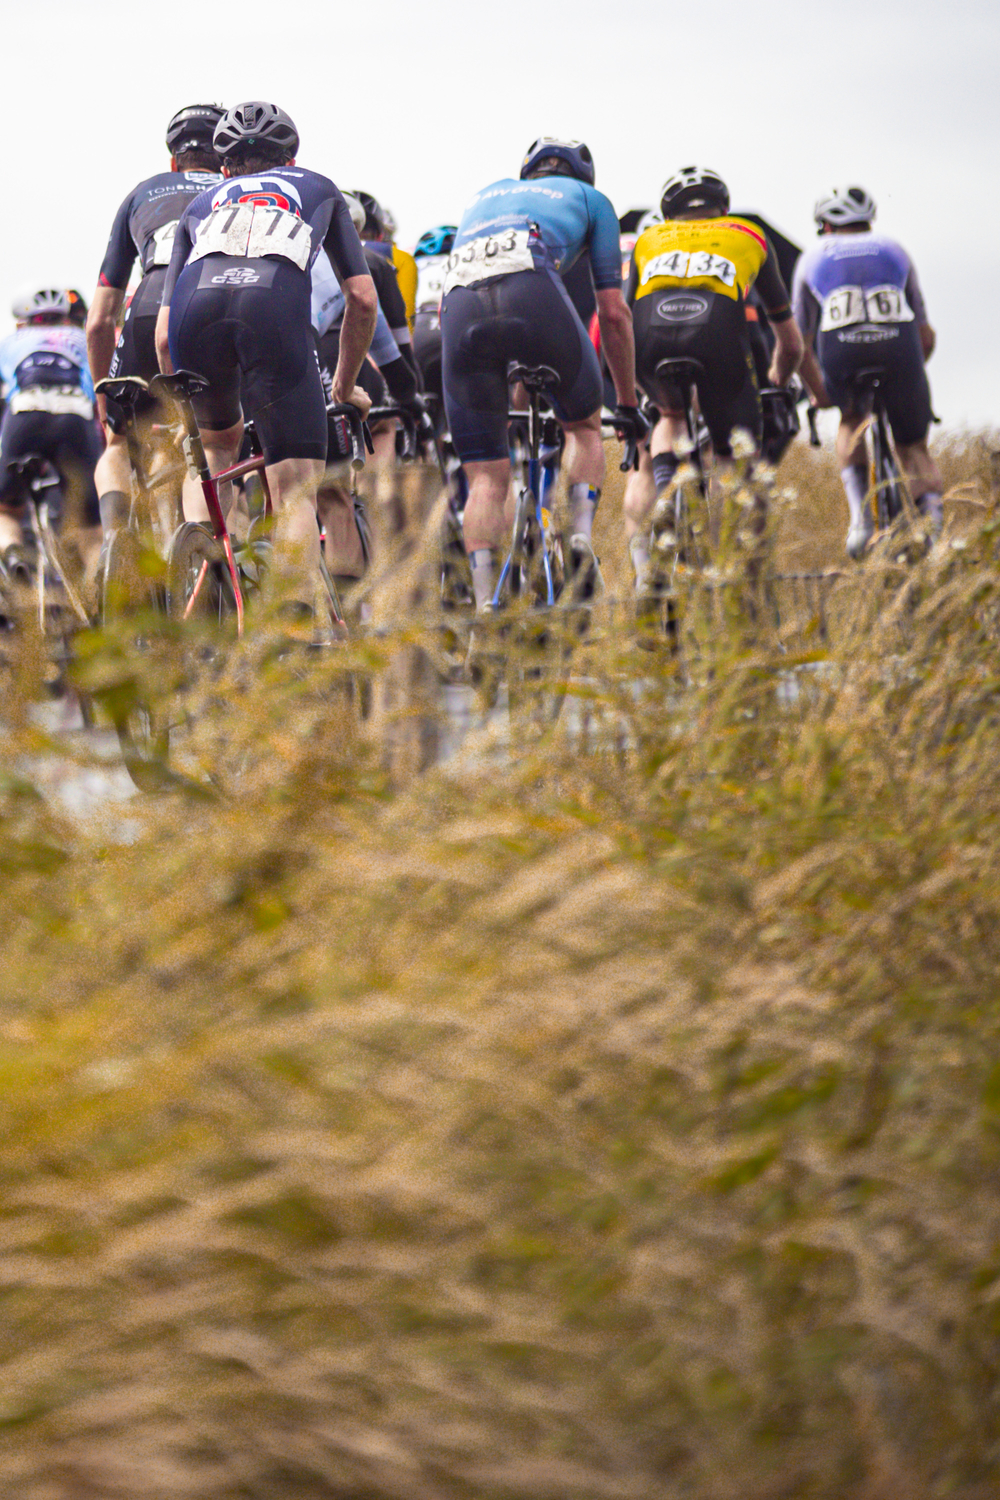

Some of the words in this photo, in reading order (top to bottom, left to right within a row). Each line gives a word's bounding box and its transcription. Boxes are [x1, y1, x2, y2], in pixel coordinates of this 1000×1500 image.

[146, 184, 207, 198] TONSCH
[264, 207, 304, 241] 77
[696, 254, 733, 277] 34
[211, 275, 260, 285] GSG
[829, 291, 852, 321] 67
